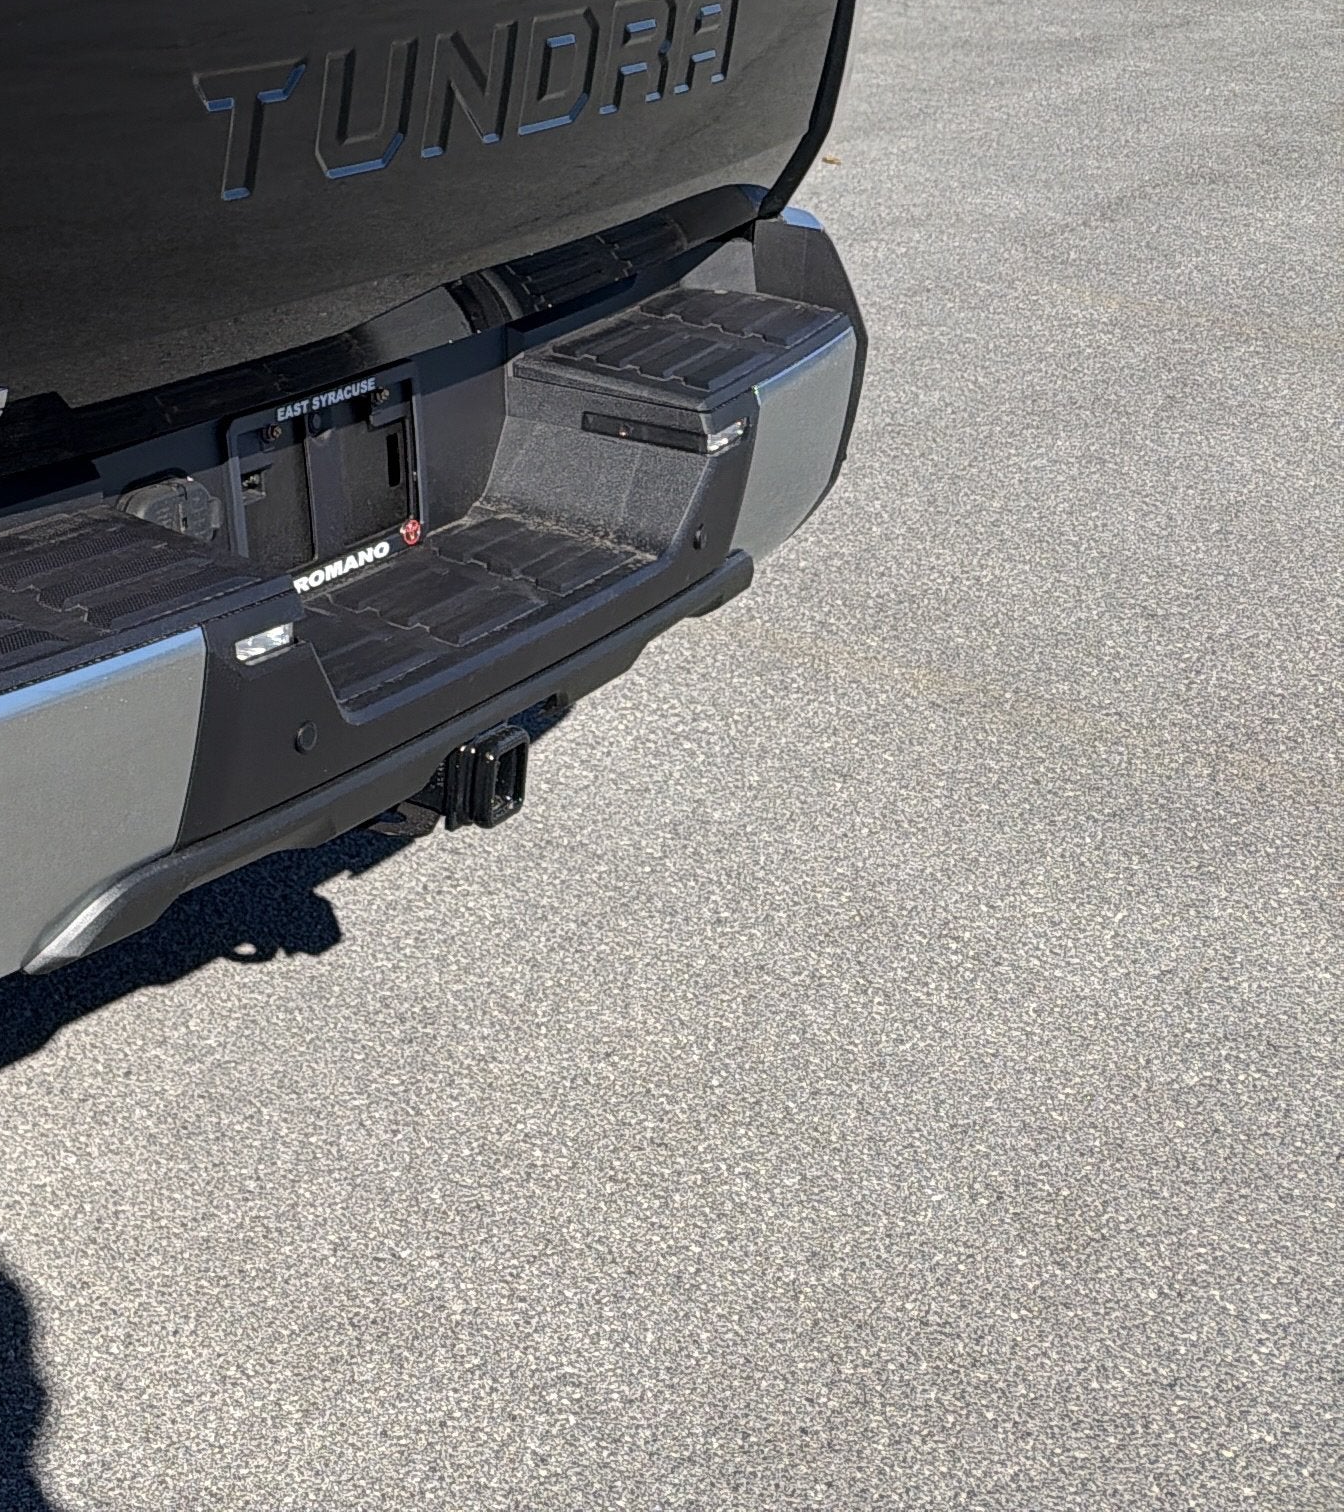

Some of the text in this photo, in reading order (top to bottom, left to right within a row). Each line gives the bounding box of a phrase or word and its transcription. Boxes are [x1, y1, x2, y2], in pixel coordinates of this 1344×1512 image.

[278, 378, 376, 422] EAST SYRACUSE
[293, 541, 390, 594] ROMANO
